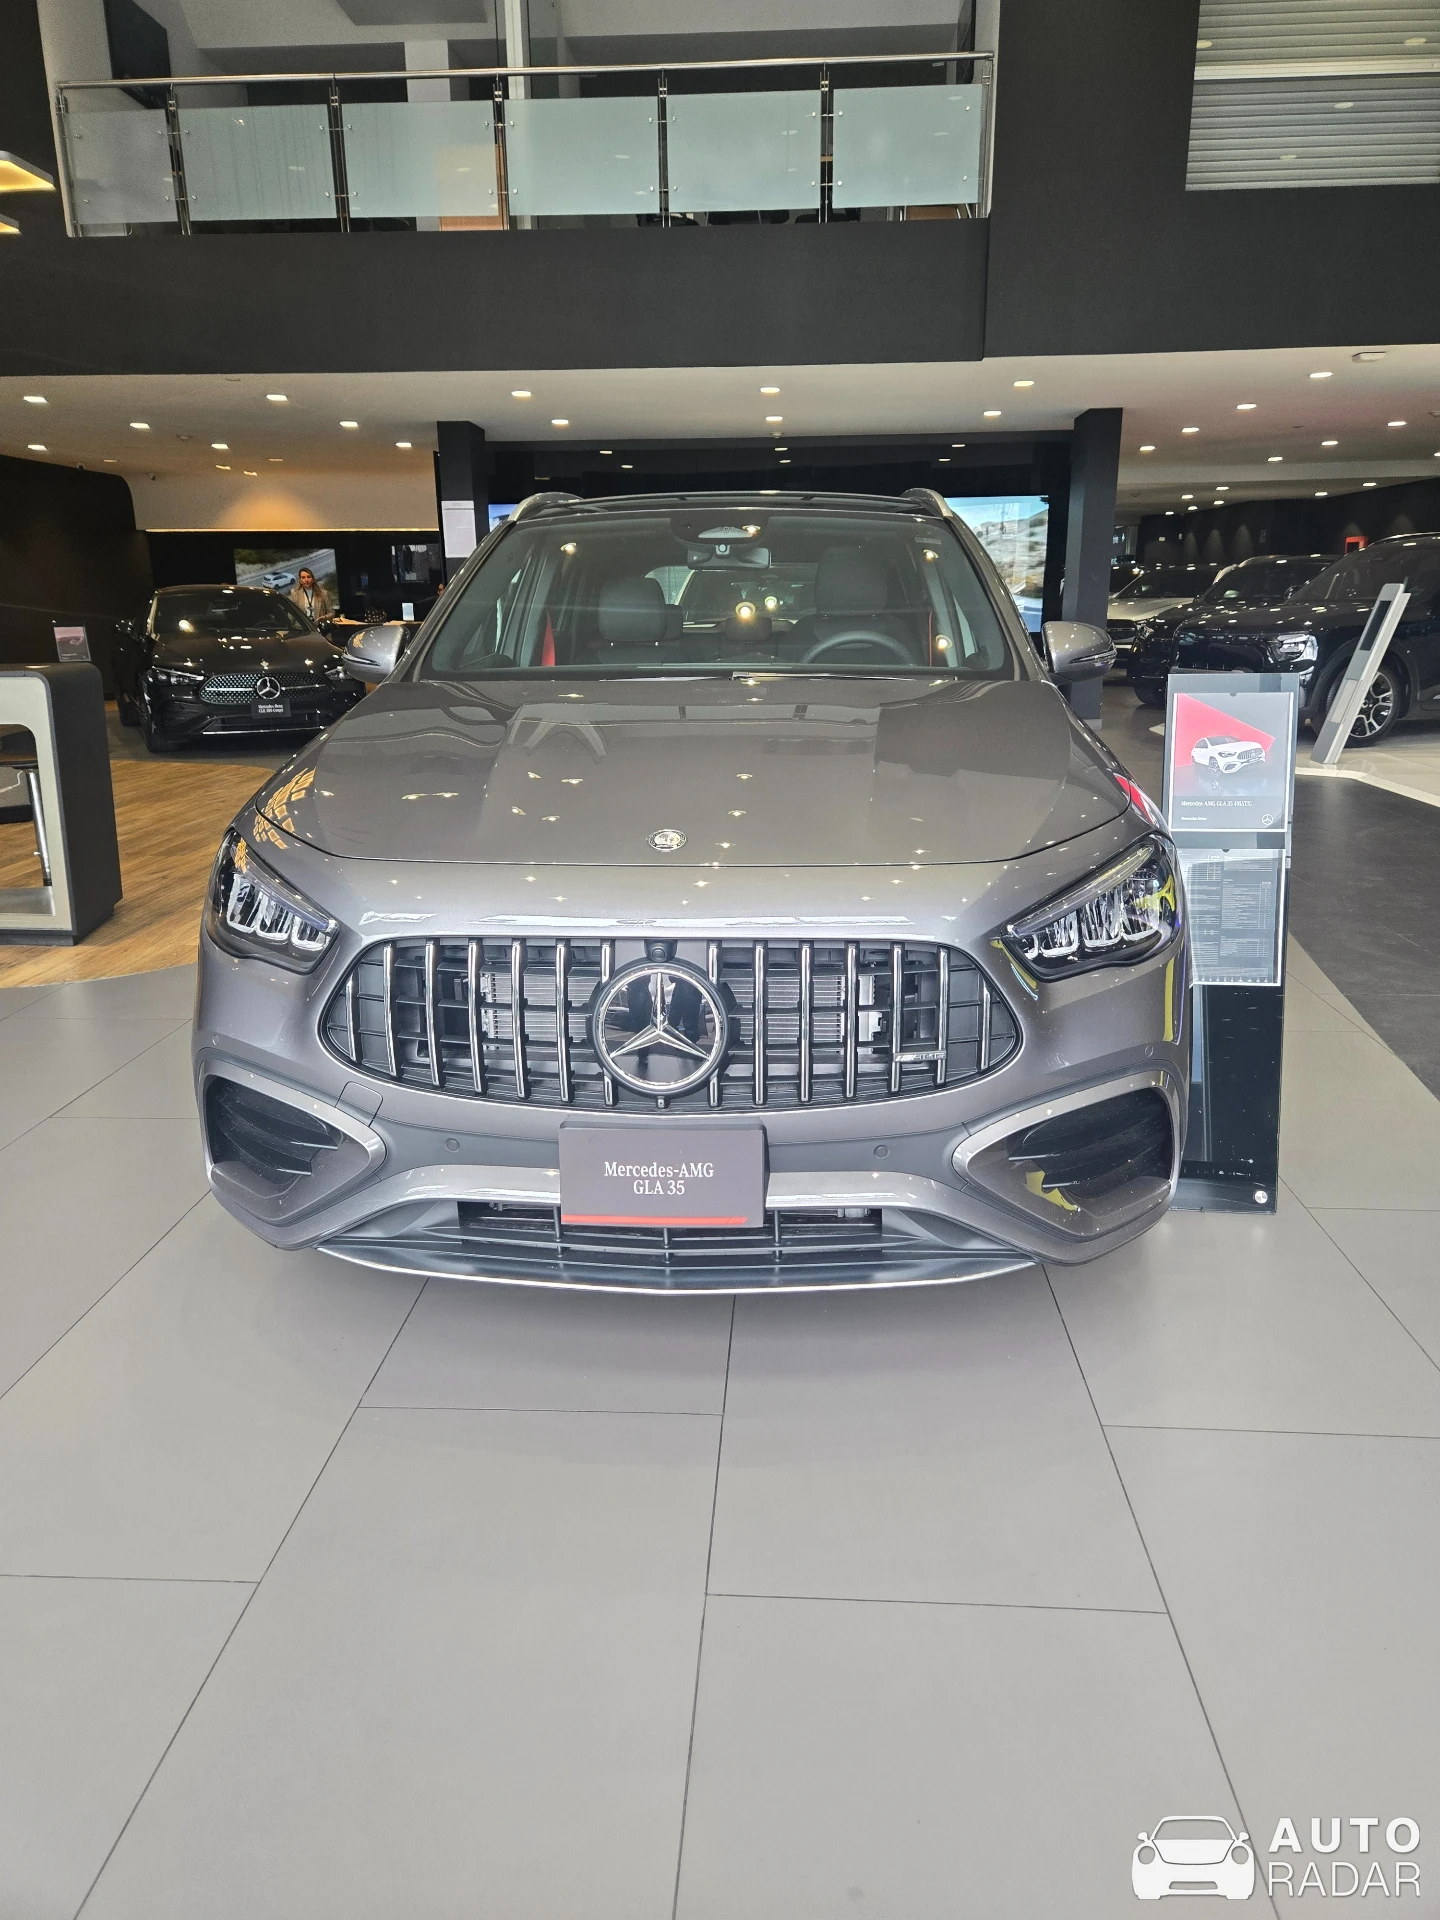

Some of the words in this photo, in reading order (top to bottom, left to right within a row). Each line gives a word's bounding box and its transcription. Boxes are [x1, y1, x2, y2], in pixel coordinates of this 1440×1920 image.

[604, 1161, 714, 1178] Mercedes-AMG
[633, 1180, 664, 1195] GLA
[667, 1180, 685, 1195] 35
